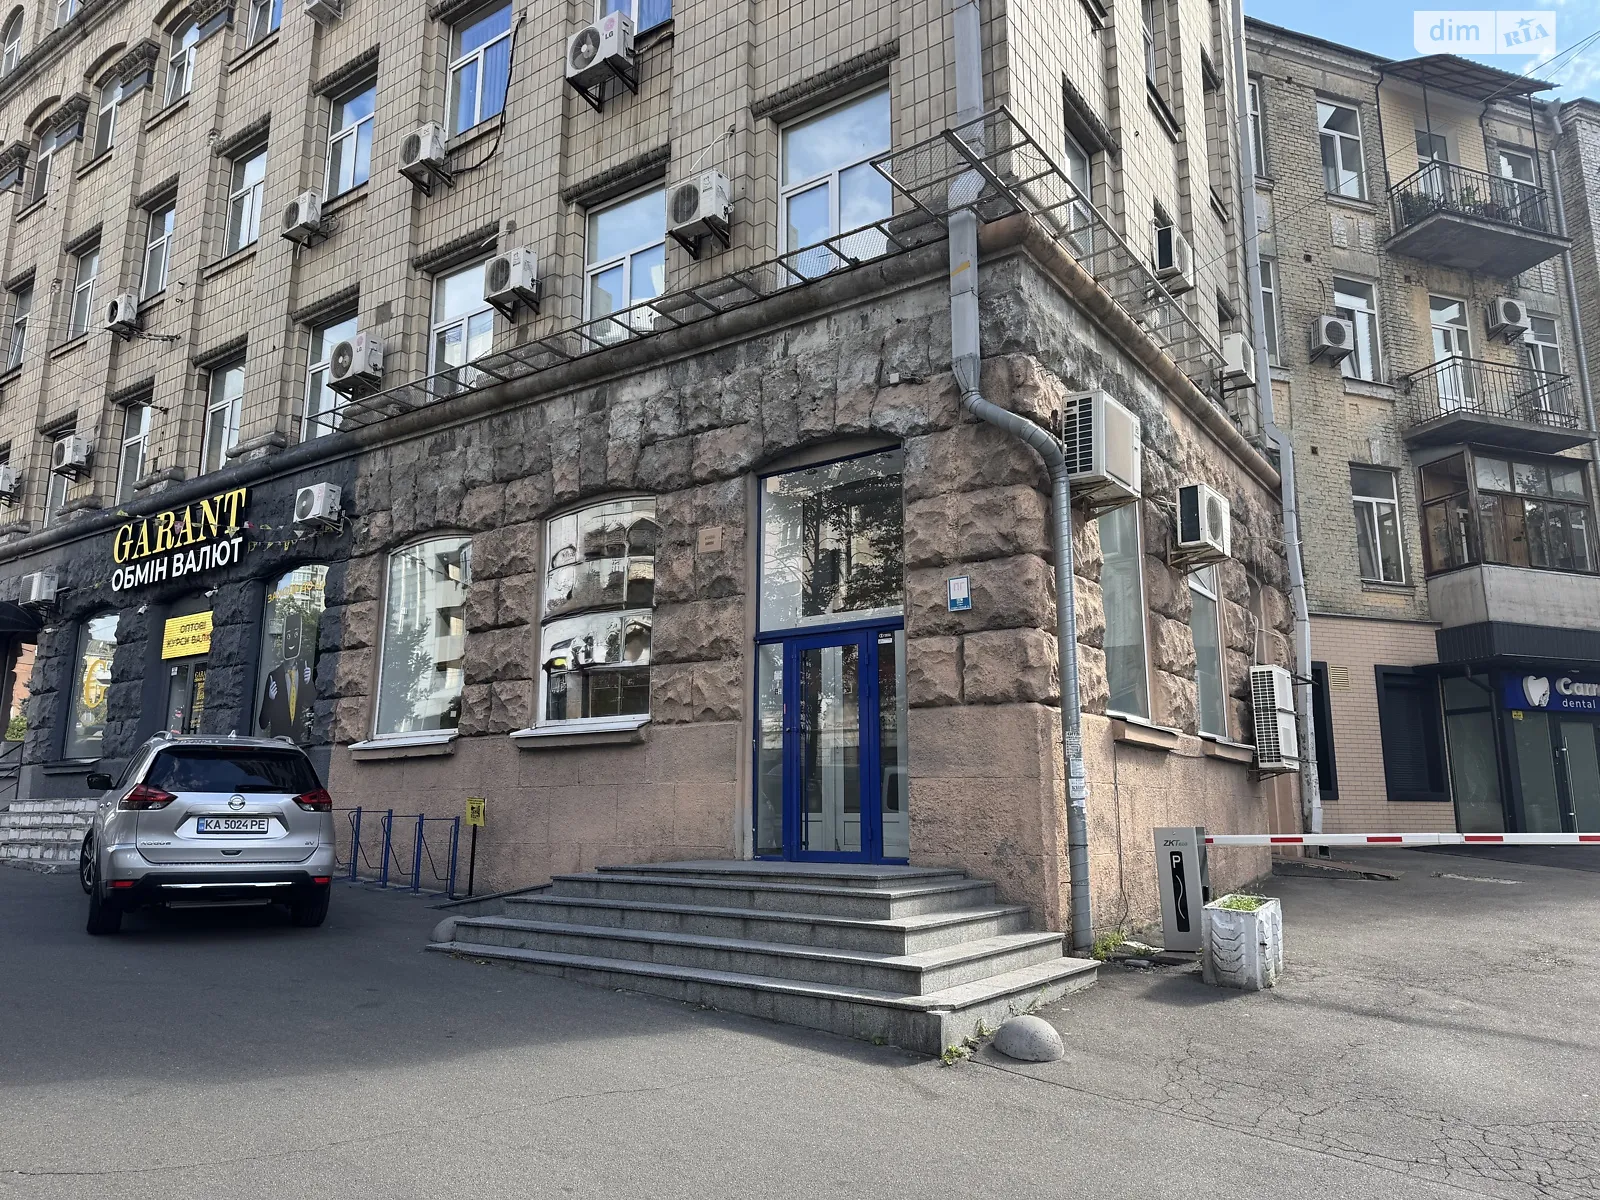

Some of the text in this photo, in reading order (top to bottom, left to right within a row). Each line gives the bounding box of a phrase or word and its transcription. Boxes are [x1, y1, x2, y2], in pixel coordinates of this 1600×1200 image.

[113, 487, 247, 564] GARANT
[111, 536, 243, 592] ОБМІН ВАЛЮТ
[1555, 677, 1600, 697] Carr
[1562, 698, 1596, 709] dental
[205, 819, 266, 830] KA 5024 PE
